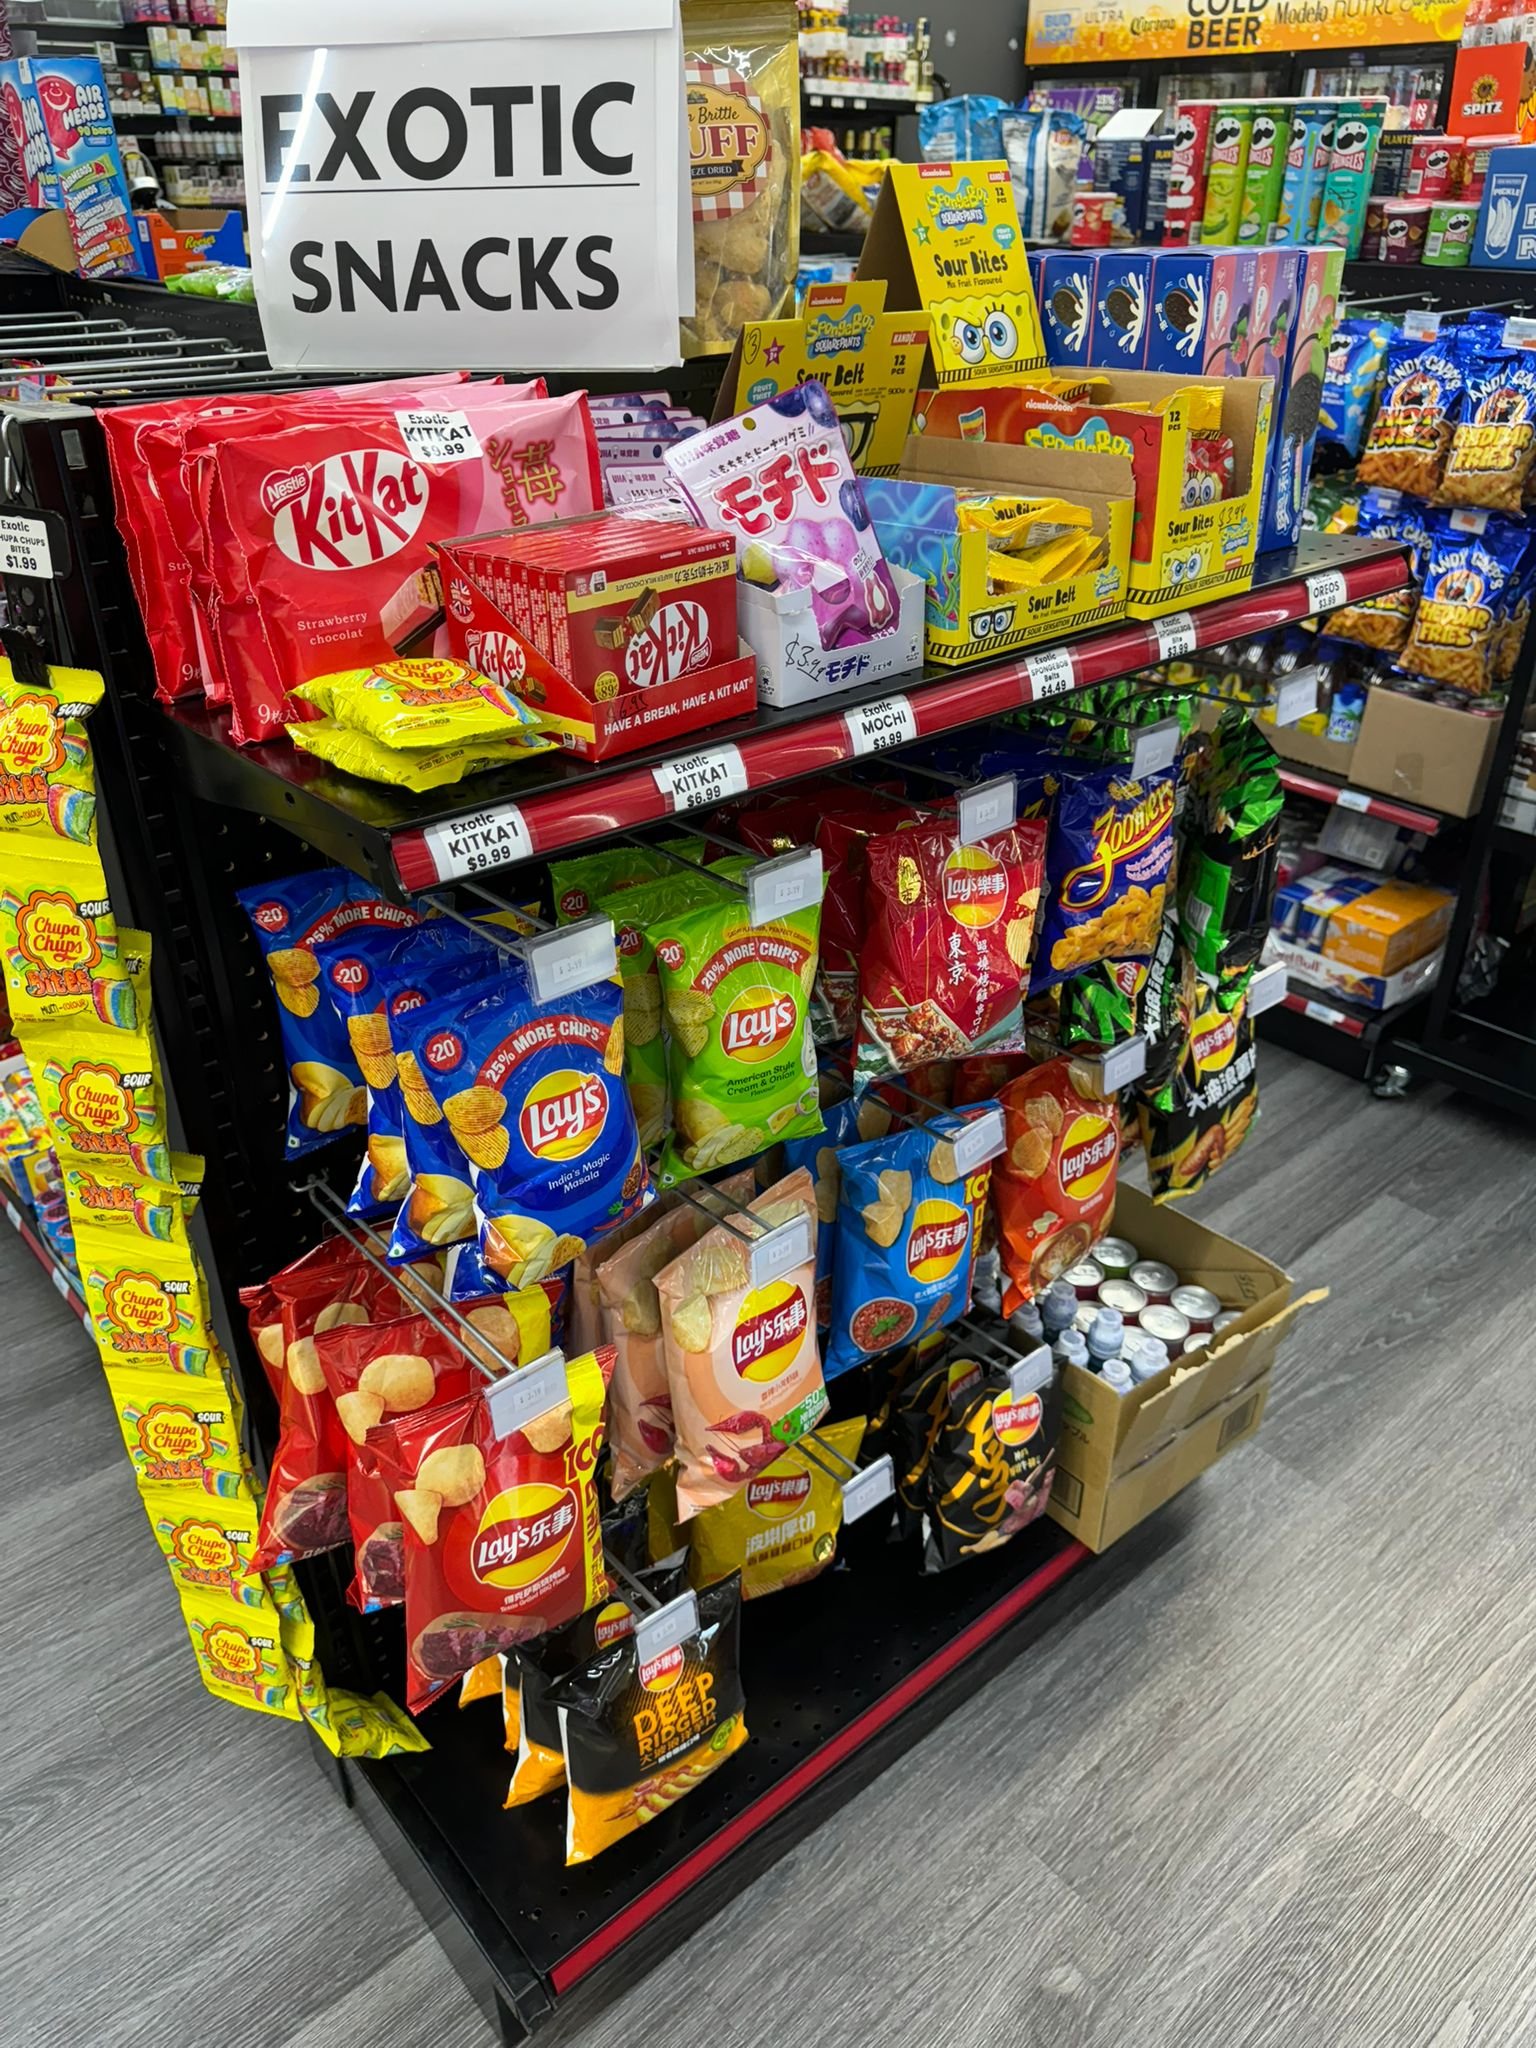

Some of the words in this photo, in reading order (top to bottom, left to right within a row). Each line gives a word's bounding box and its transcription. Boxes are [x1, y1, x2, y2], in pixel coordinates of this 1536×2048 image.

[1084, 10, 1124, 24] ULTRA
[1274, 3, 1328, 25] Modelo
[1187, 16, 1262, 48] BEER
[74, 84, 104, 107] AIR
[62, 102, 107, 131] HEADS
[698, 106, 740, 125] Brittle
[1462, 101, 1503, 116] SPITZ
[261, 82, 636, 184] EXOTIC
[707, 164, 733, 175] DRIED
[1329, 152, 1366, 173] PRINGLES
[995, 187, 1005, 197] 12
[1493, 187, 1521, 197] PICKLE
[933, 253, 968, 278] Sour
[969, 248, 1009, 275] Bites
[289, 235, 620, 313] SNACKS
[814, 335, 862, 353] SQUAREPANTS
[893, 354, 907, 367] 12
[833, 362, 865, 387] Belt
[890, 367, 906, 376] PCS
[1386, 356, 1421, 387] ANDY
[752, 382, 773, 394] FRUIT
[1468, 370, 1509, 402] ANDY
[1025, 399, 1073, 413] nickelodeon
[1167, 410, 1181, 423] 12
[407, 413, 451, 425] Exotic
[1167, 423, 1181, 431] PCS
[1375, 406, 1443, 430] HOT
[403, 425, 473, 442] KITKAT
[1367, 424, 1440, 451] FRIES
[1453, 423, 1535, 449] CHEDDAR
[421, 443, 465, 458] $9.99
[1452, 444, 1521, 473] FRIES
[713, 444, 840, 536] モチド
[288, 451, 424, 568] KitKat
[1, 521, 30, 533] Exotic
[1168, 520, 1192, 538] Sour
[1192, 513, 1214, 532] Bites
[10, 544, 31, 556] BITES
[21, 536, 46, 548] CHUPS
[5, 555, 38, 571] $1.99
[1428, 548, 1469, 577] ANDY
[1470, 552, 1505, 591] CAPP'S
[1028, 595, 1052, 614] Sour
[1055, 584, 1076, 608] Belt
[1312, 582, 1340, 598] OREOS
[1318, 595, 1337, 610] $3.99
[297, 612, 368, 631] Strawberry
[1026, 627, 1043, 637] SOUR
[1042, 618, 1071, 633] SENSATION
[1158, 624, 1193, 640] SPONGEBOB
[1161, 616, 1182, 629] Exotic
[309, 628, 364, 646] chocolat
[630, 602, 702, 686] KitKat
[1417, 623, 1474, 646] FRIES
[475, 633, 524, 687] KitKat
[1034, 652, 1057, 665] Exotic
[1167, 642, 1189, 658] $3.99
[393, 666, 455, 685] Chups
[825, 655, 871, 683] モチド
[1031, 661, 1069, 677] SPONGEBOB
[1040, 679, 1067, 698] $4.49
[257, 704, 297, 725] 9枚入
[603, 718, 632, 736] HAVE
[633, 716, 642, 726] A
[643, 705, 680, 722] BREAK,
[681, 695, 707, 711] HAVE
[707, 694, 716, 703] A
[716, 685, 732, 698] KIT
[732, 679, 749, 693] KAT
[861, 700, 894, 719] Exotic
[6, 717, 49, 737] Chupa
[861, 710, 907, 737] MOCHI
[1, 735, 43, 767] Chups
[872, 730, 903, 751] $3.99
[671, 754, 710, 776] Exotic
[671, 761, 730, 797] KITKAT
[686, 784, 722, 808] $6.99
[450, 811, 495, 836] Exotic
[447, 820, 522, 859] KITKAT
[466, 844, 512, 873] $9.99
[80, 899, 111, 917] SOUR
[332, 906, 371, 928] MORE
[373, 906, 415, 928] CHIPS
[34, 916, 81, 937] Chupa
[33, 934, 83, 963] Chups
[948, 932, 967, 986] 東京
[701, 960, 726, 990] 20%
[722, 942, 756, 966] MORE
[759, 941, 800, 964] CHIPS
[26, 968, 92, 997] Bites
[40, 998, 87, 1015] MULTI-COLOUR
[727, 998, 794, 1050] Lay's
[485, 1051, 516, 1083] 25%
[511, 1021, 557, 1054] MORE
[558, 1020, 601, 1044] CHIPS
[123, 1073, 152, 1088] SOUR
[726, 1067, 772, 1087] American
[773, 1060, 796, 1078] Style
[726, 1081, 759, 1097] Cream
[759, 1077, 768, 1088] &
[768, 1069, 796, 1086] Onion
[76, 1085, 119, 1107] Chupa
[74, 1102, 121, 1127] Chups
[531, 1082, 603, 1150] Lay's
[547, 1168, 581, 1192] India's
[581, 1151, 612, 1176] Magic
[562, 1168, 601, 1195] Masala
[163, 1281, 189, 1294] SOUR
[121, 1290, 164, 1308] Chupa
[120, 1303, 165, 1327] Chups
[197, 1412, 222, 1423] SOUR
[153, 1422, 197, 1441] Chupa
[152, 1434, 198, 1455] Chups
[187, 1533, 227, 1550] Chupa
[225, 1530, 250, 1543] SOUR
[186, 1544, 228, 1565] Chups
[215, 1636, 251, 1656] Chupa
[250, 1637, 272, 1648] SOUR
[215, 1647, 251, 1668] Chups
[633, 1671, 714, 1741] DEEP
[638, 1697, 718, 1756] RIDGED
